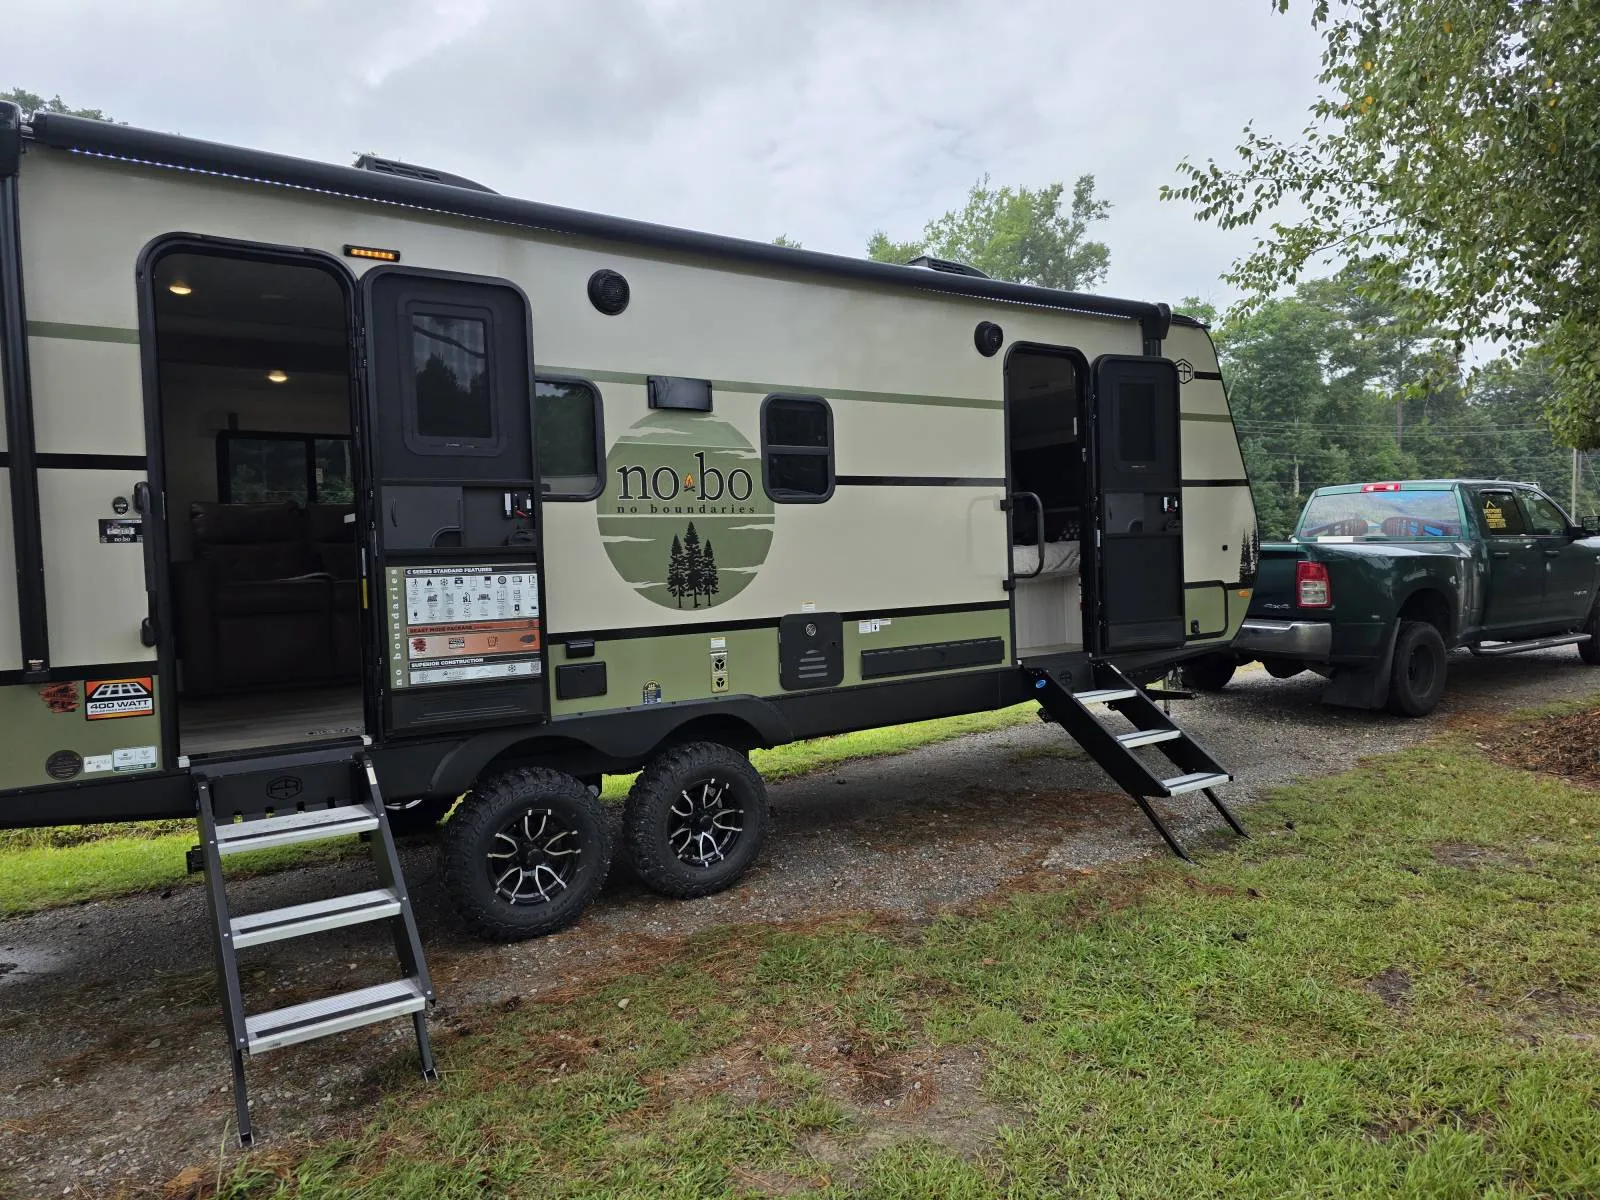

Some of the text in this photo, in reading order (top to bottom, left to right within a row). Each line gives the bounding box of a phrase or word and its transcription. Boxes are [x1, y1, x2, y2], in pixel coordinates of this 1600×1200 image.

[617, 504, 755, 513] no boundaries
[390, 569, 402, 686] no boundaries
[441, 657, 484, 666] CONSTRUCTION
[90, 702, 115, 710] 400
[117, 699, 149, 708] WATT
